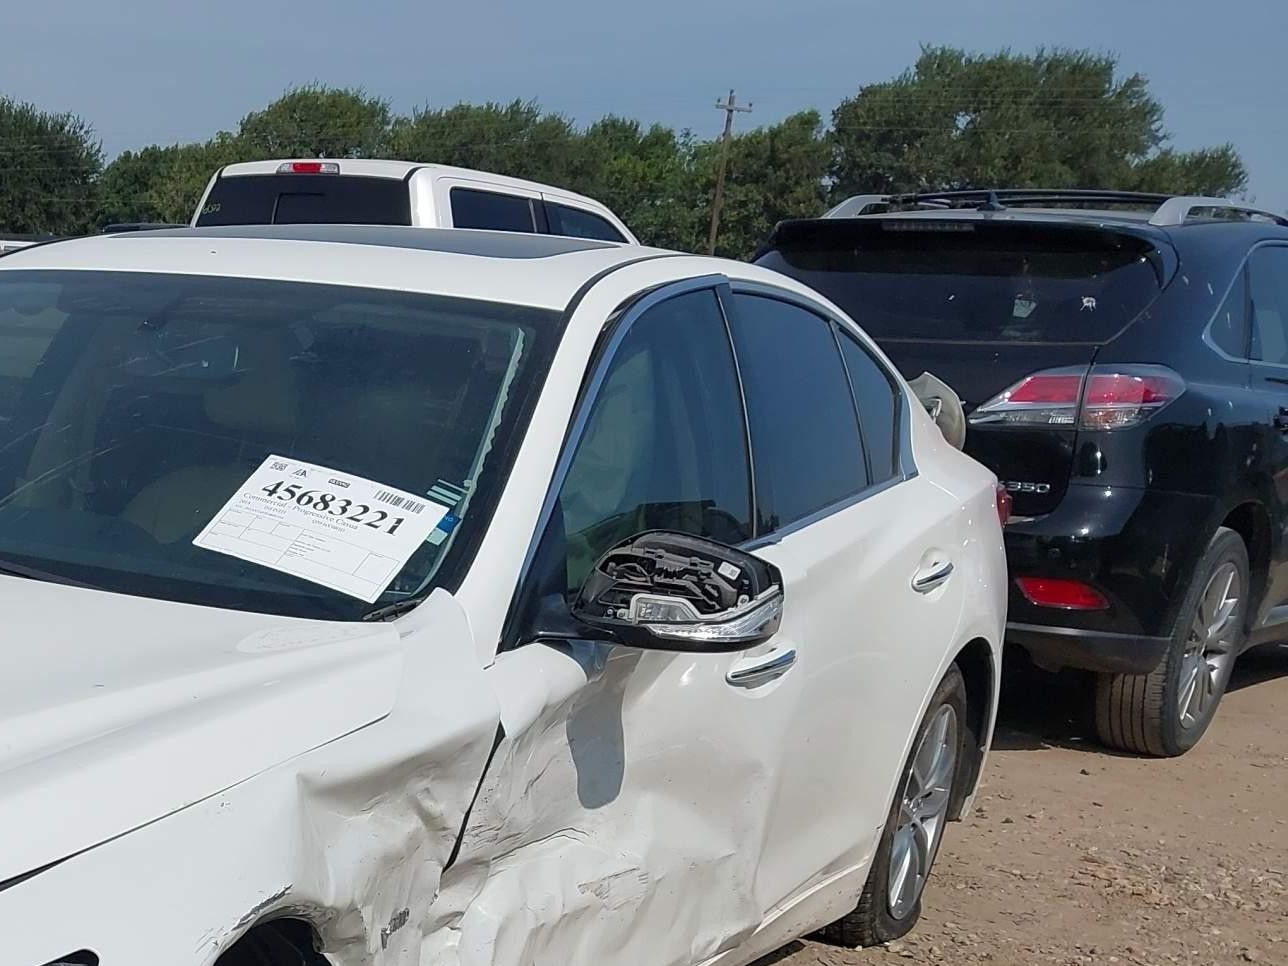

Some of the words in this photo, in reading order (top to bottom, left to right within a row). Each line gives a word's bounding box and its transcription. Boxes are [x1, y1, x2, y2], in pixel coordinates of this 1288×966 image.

[1006, 480, 1051, 494] 350
[243, 492, 288, 509] Commercial
[293, 505, 336, 524] Progressive
[261, 480, 405, 536] 45683221
